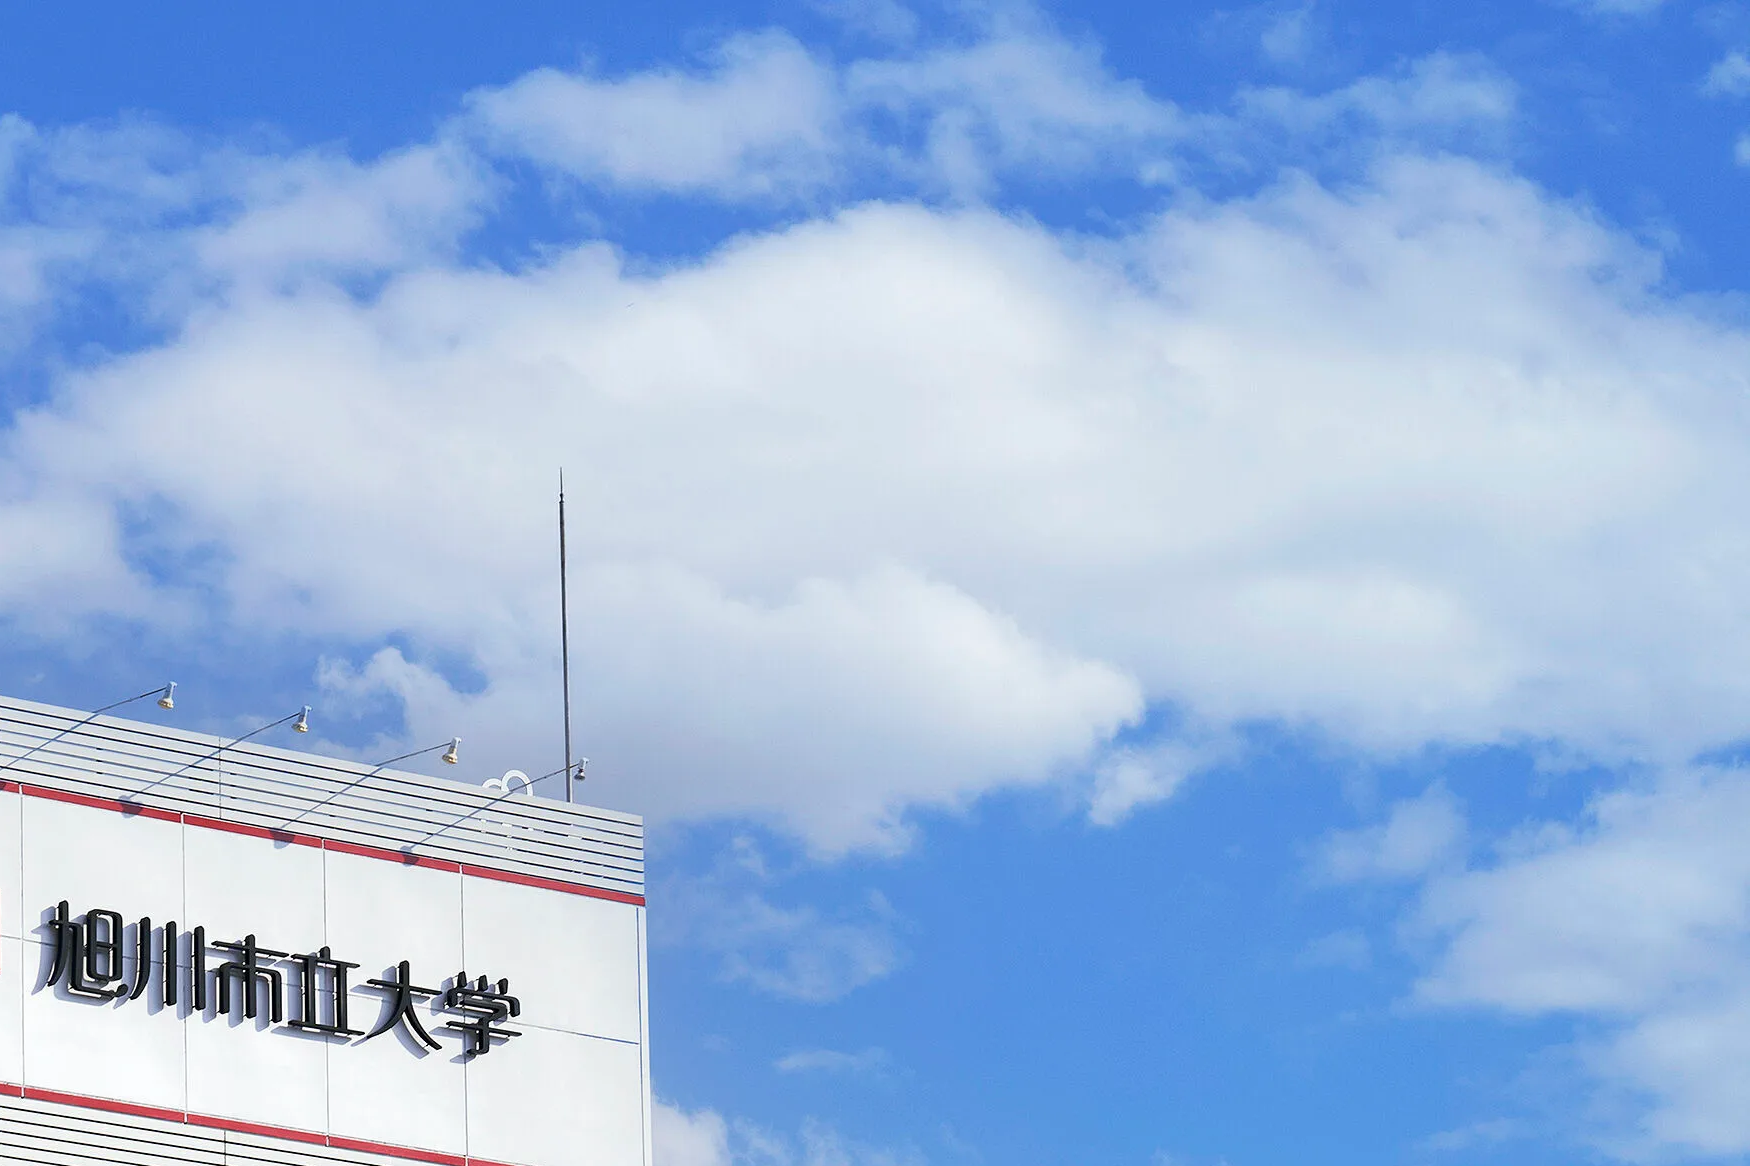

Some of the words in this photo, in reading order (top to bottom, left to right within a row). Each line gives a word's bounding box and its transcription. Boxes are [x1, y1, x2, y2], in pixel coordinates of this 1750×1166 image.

[47, 899, 523, 1056] 旭川市立大学
